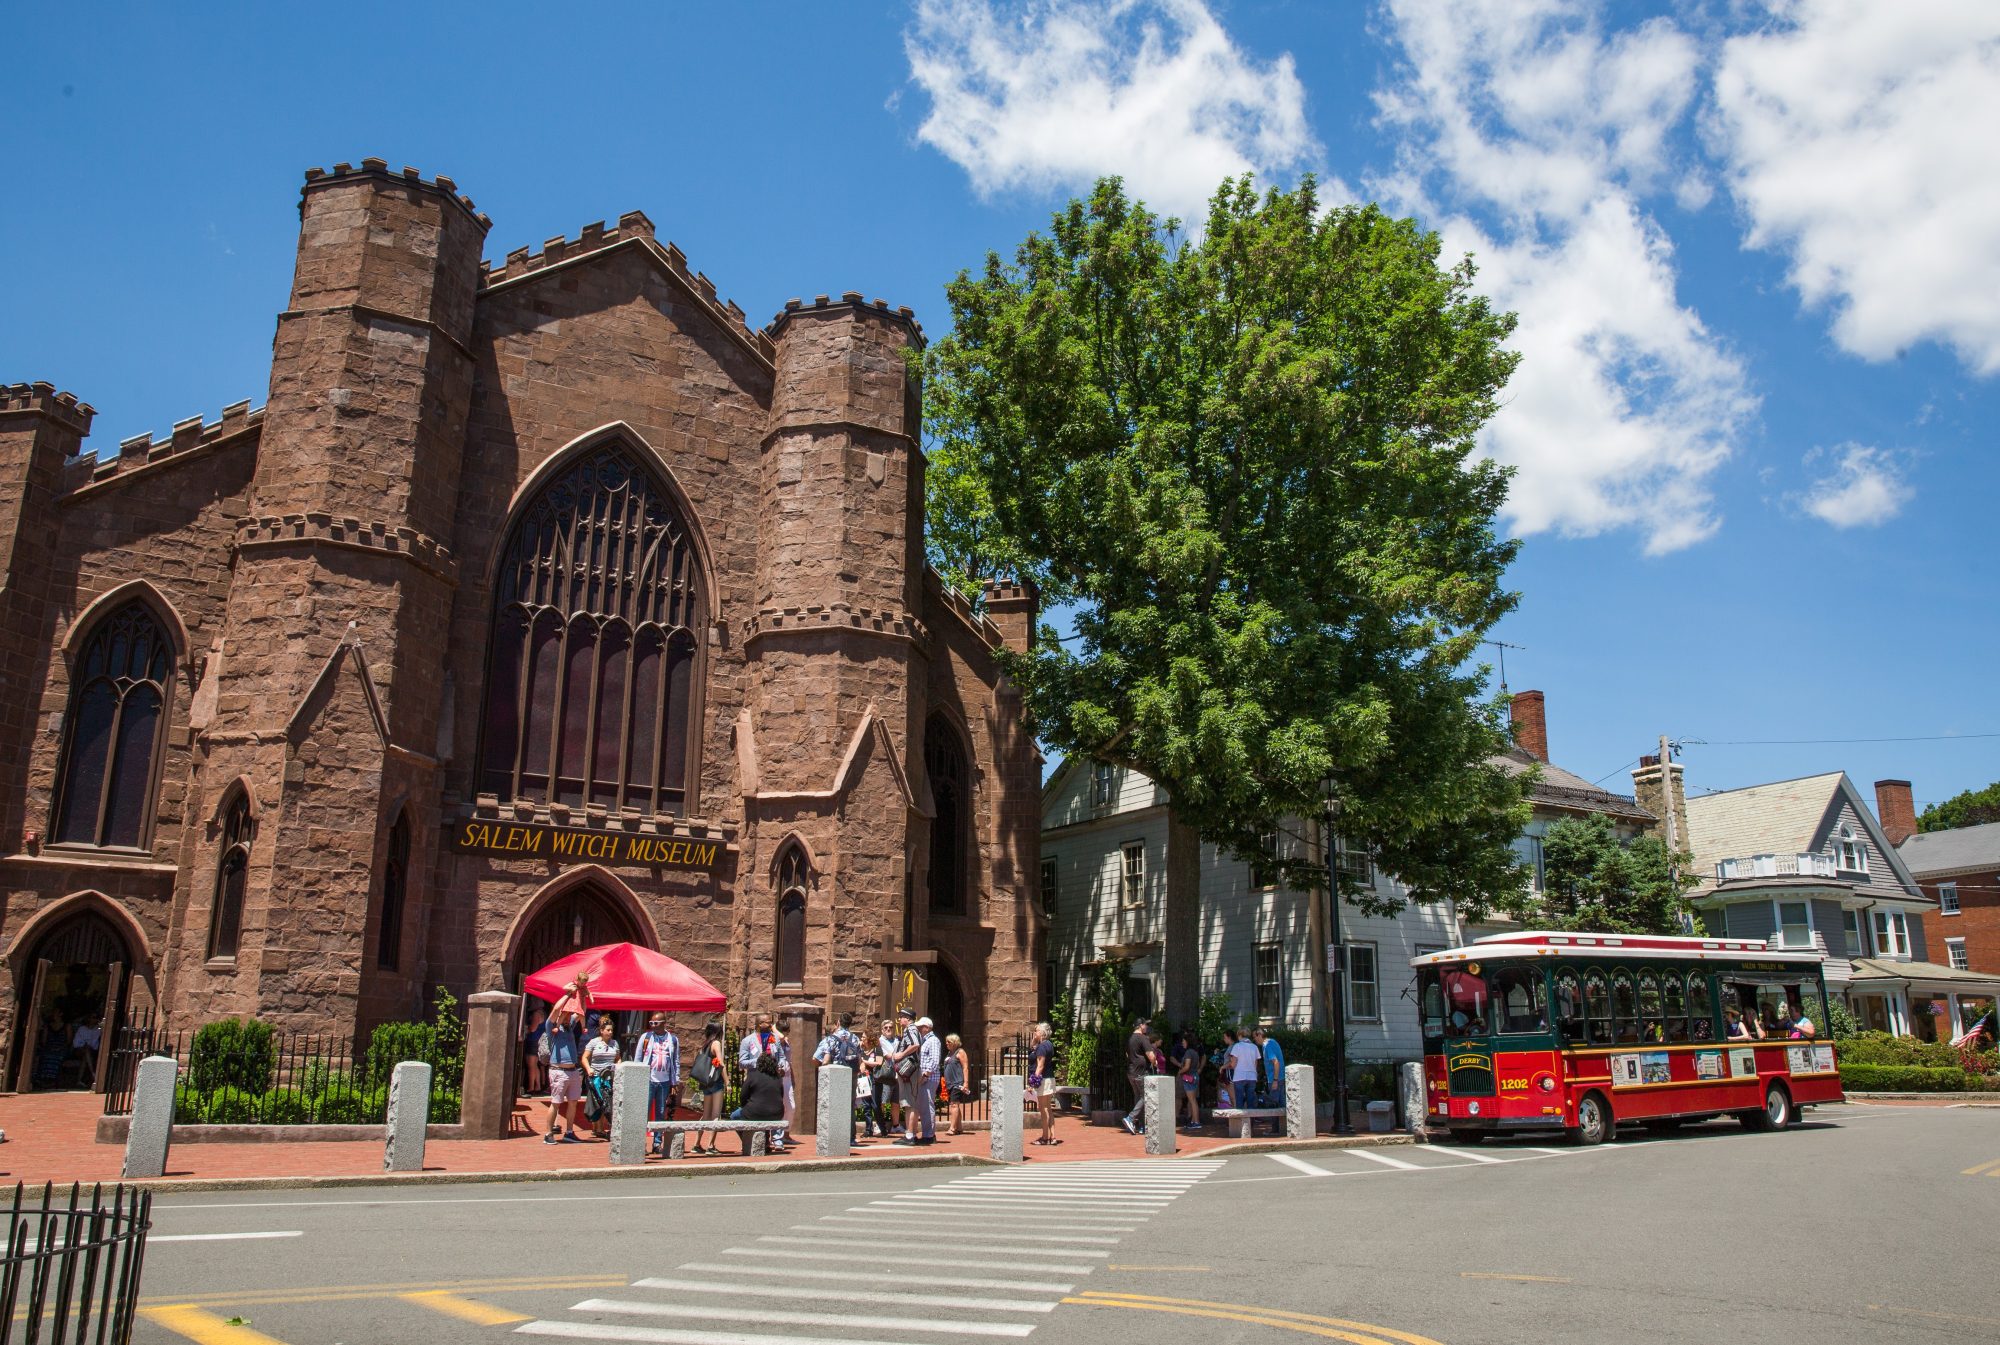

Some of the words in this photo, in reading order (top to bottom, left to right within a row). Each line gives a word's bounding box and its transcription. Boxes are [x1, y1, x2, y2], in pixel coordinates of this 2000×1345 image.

[461, 823, 544, 852] SALEM
[552, 831, 619, 859] WITCH
[626, 838, 717, 867] MUSEUM
[1459, 1057, 1481, 1065] DERBY
[1501, 1078, 1529, 1090] 1202
